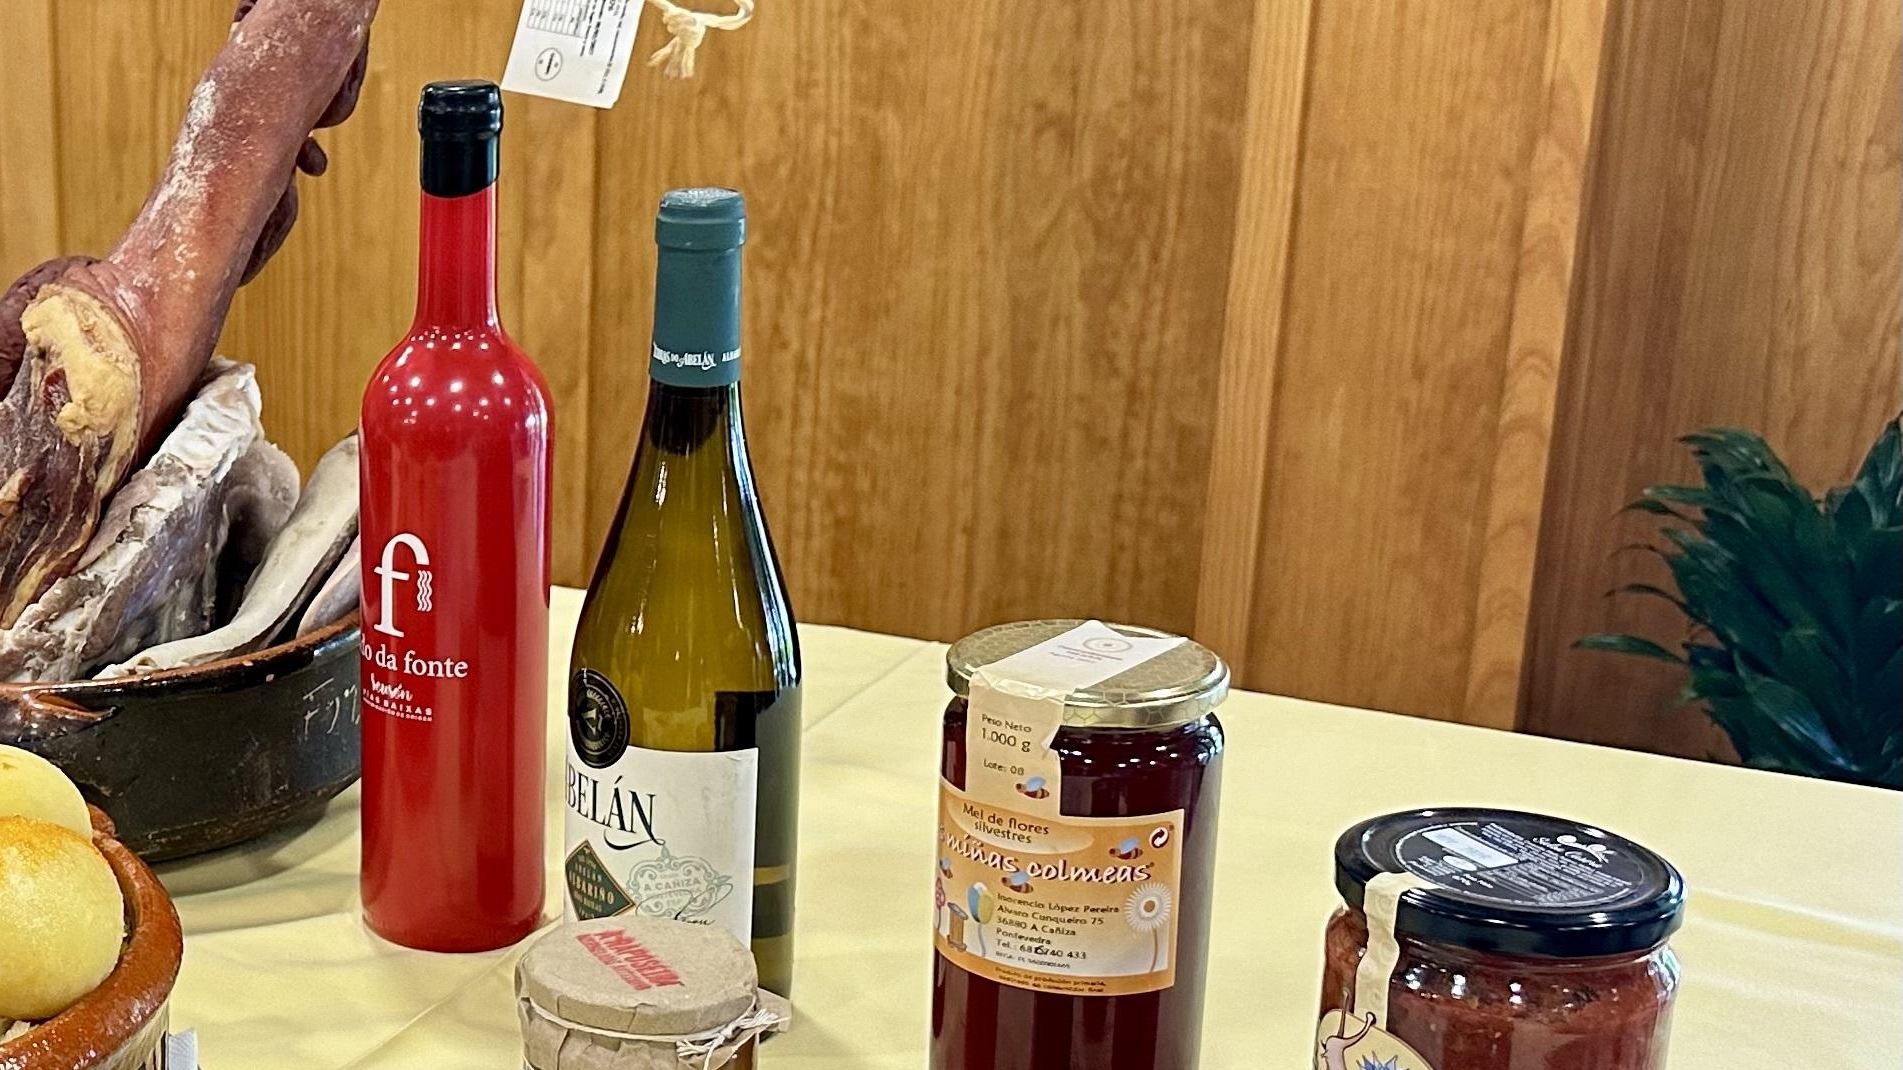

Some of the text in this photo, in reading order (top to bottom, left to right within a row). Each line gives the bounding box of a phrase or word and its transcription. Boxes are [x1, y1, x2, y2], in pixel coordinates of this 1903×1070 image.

[374, 533, 430, 638] f
[375, 643, 469, 678] da fonte
[981, 713, 1032, 734] Peso Neto
[980, 727, 1032, 754] 1.000 g
[567, 760, 665, 851] BELÁN
[963, 803, 1049, 836] Mel de flores
[974, 820, 1032, 845] silvestres
[1026, 859, 1154, 885] colmeas
[1030, 923, 1076, 936] A Cañiza
[1091, 917, 1105, 926] 75
